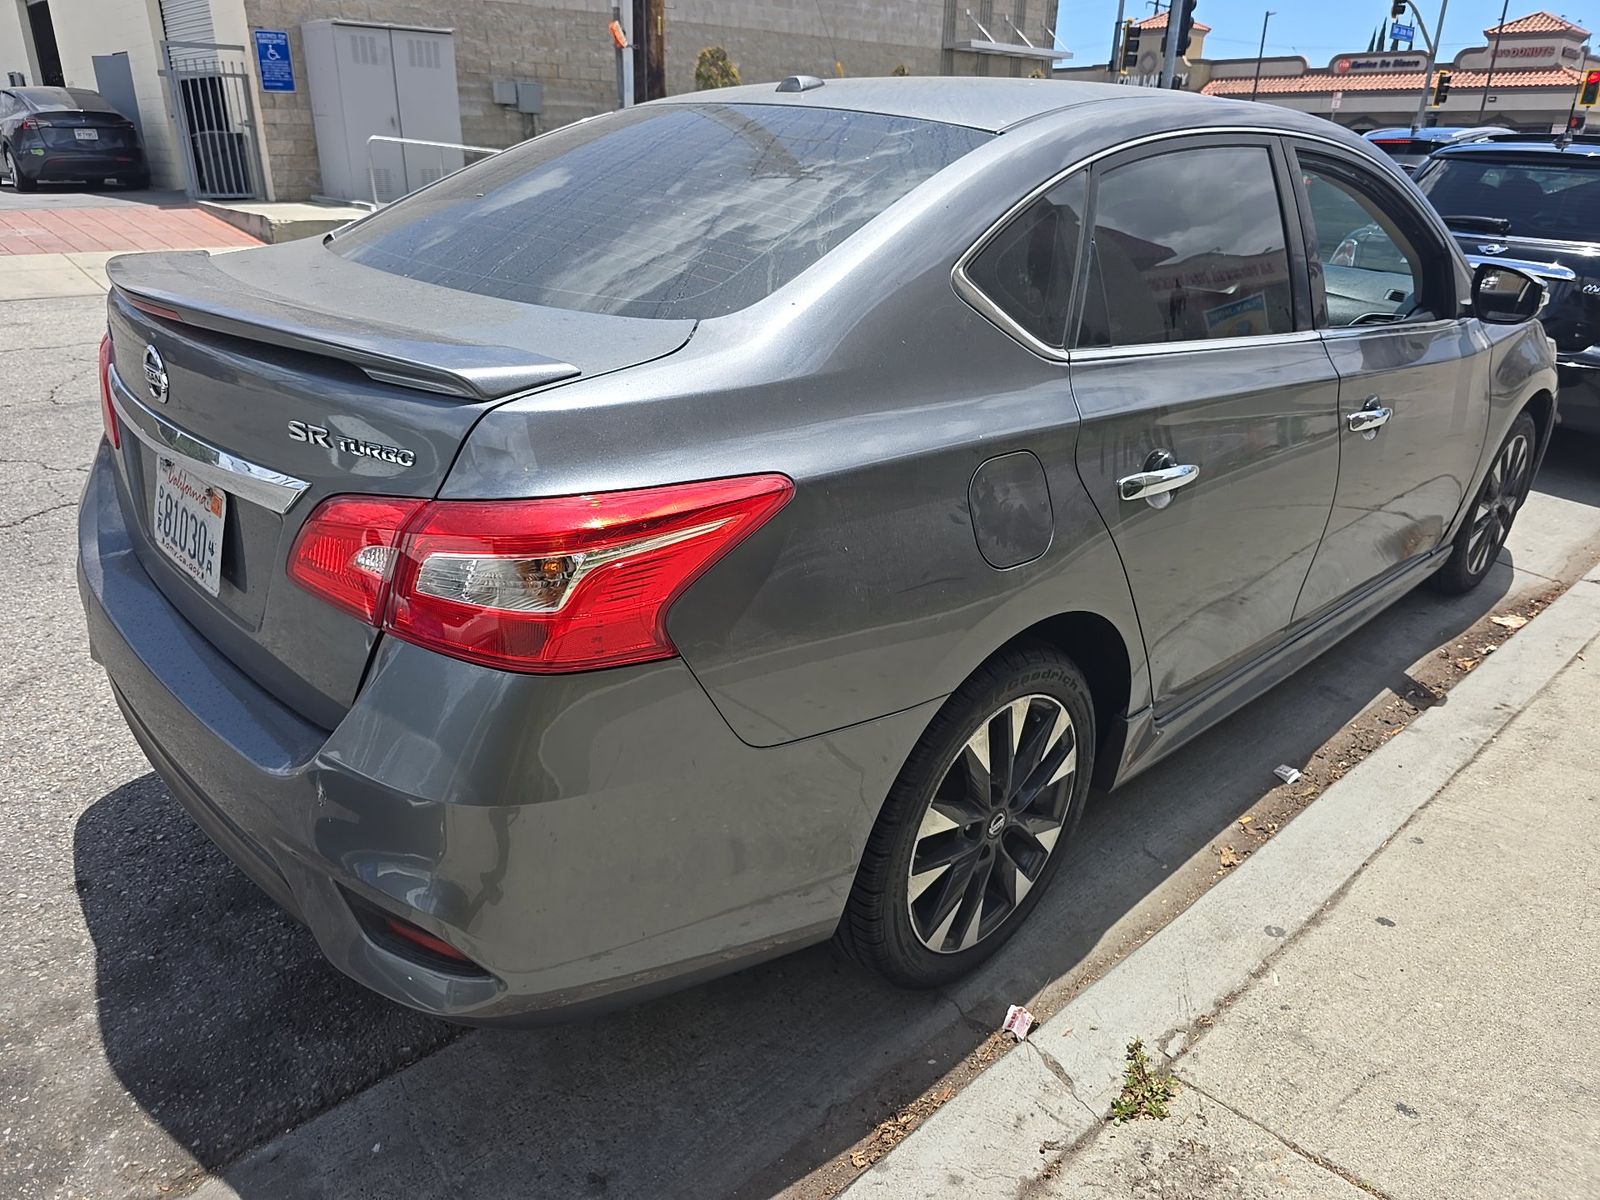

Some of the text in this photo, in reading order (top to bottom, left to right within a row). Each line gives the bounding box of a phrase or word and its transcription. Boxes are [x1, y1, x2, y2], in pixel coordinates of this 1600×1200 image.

[1510, 46, 1556, 58] DONUTS
[287, 420, 416, 467] SR TURBO
[167, 464, 208, 506] California
[163, 493, 207, 569] 81030
